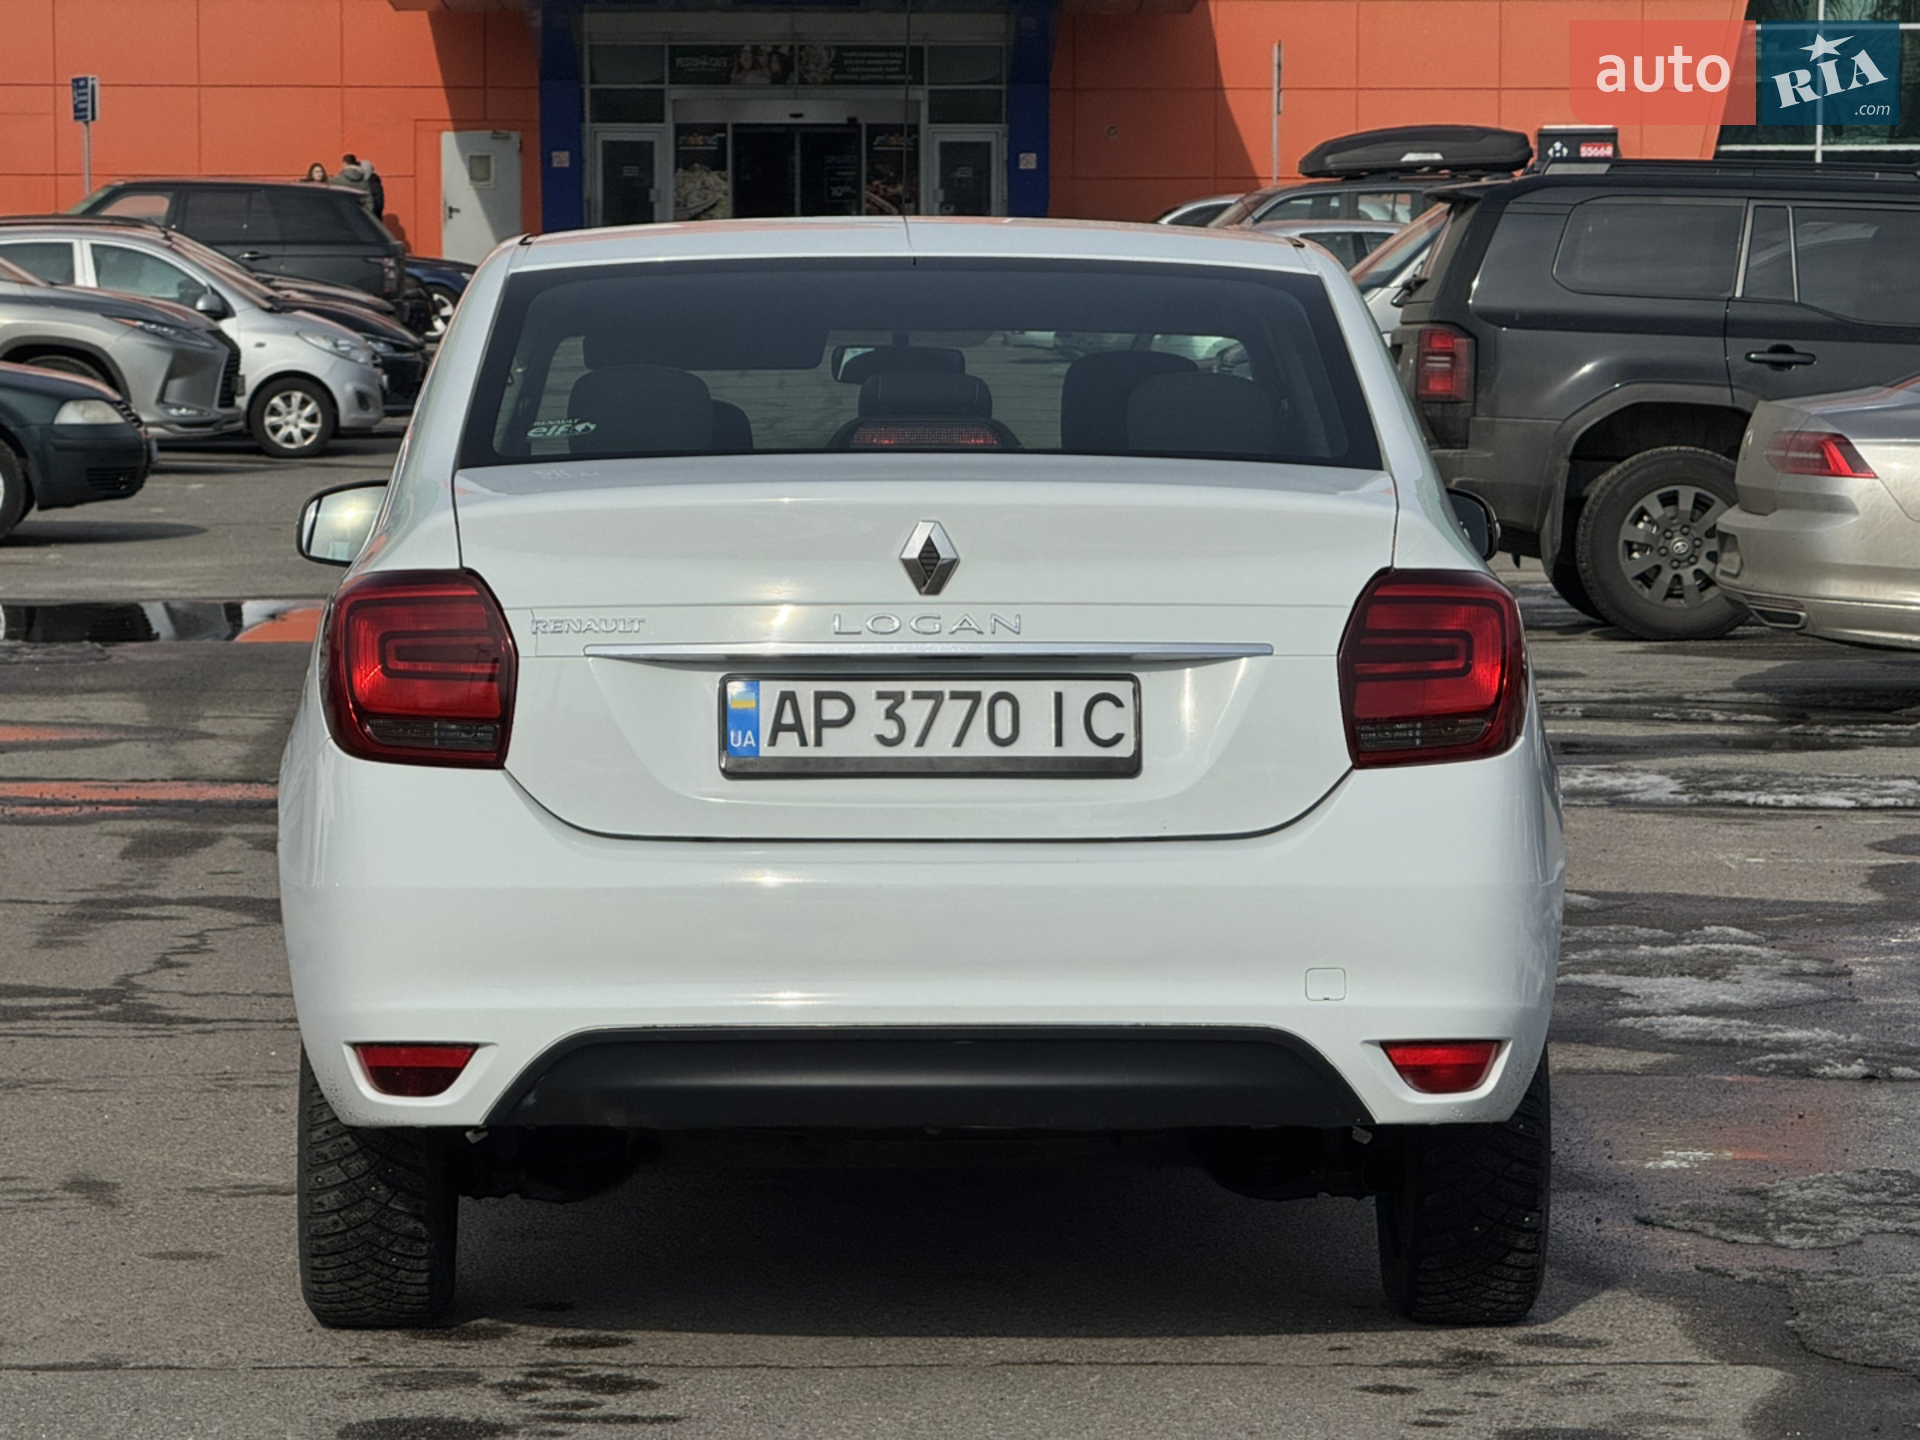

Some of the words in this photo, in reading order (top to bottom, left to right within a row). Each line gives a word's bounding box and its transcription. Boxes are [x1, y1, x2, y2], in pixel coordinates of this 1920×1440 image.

[533, 418, 580, 426] RENAULT
[531, 617, 646, 634] RENAULT
[832, 612, 1022, 636] LOGAN
[765, 690, 856, 749] AP
[873, 689, 1020, 749] 3770
[730, 731, 756, 748] UA
